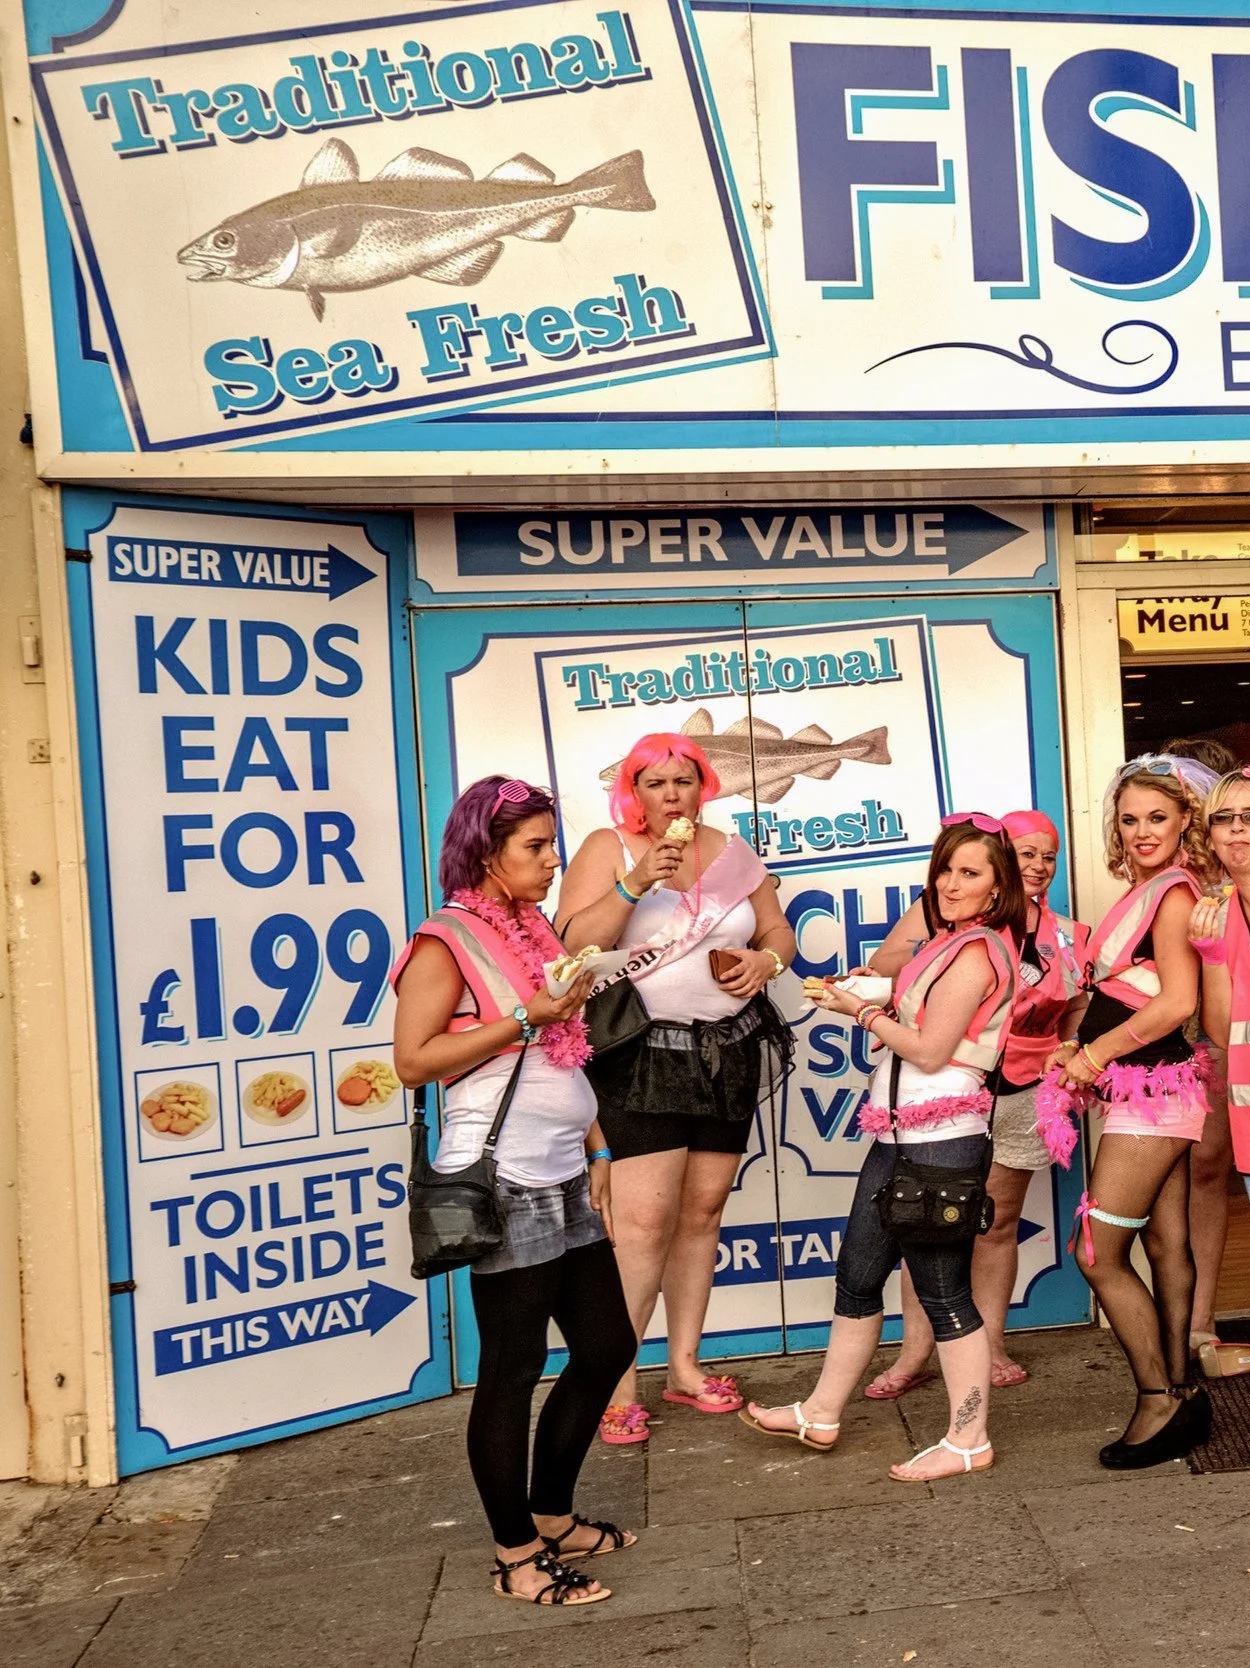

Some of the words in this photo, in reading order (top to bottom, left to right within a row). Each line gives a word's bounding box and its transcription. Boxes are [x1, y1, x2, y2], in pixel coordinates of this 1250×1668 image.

[81, 11, 652, 159] Traditional
[204, 335, 398, 420] Sea
[407, 273, 696, 383] Fresh
[113, 542, 222, 582] SUPER
[233, 551, 330, 588] VALUE
[517, 518, 727, 566] SUPER
[741, 513, 947, 560] VALUE
[1237, 543, 1250, 551] Tea
[135, 615, 363, 698] KIDS
[1137, 609, 1229, 633] Menu
[562, 637, 902, 711] Traditional
[162, 716, 349, 793] EAT
[162, 811, 365, 892] FOR
[732, 799, 908, 857] Fresh
[139, 908, 395, 1047] £1.99
[150, 1163, 406, 1248] TOILETS
[184, 1221, 386, 1304] INSIDE
[770, 1231, 841, 1267] TA
[171, 1316, 270, 1365] THIS
[279, 1293, 372, 1339] WAY
